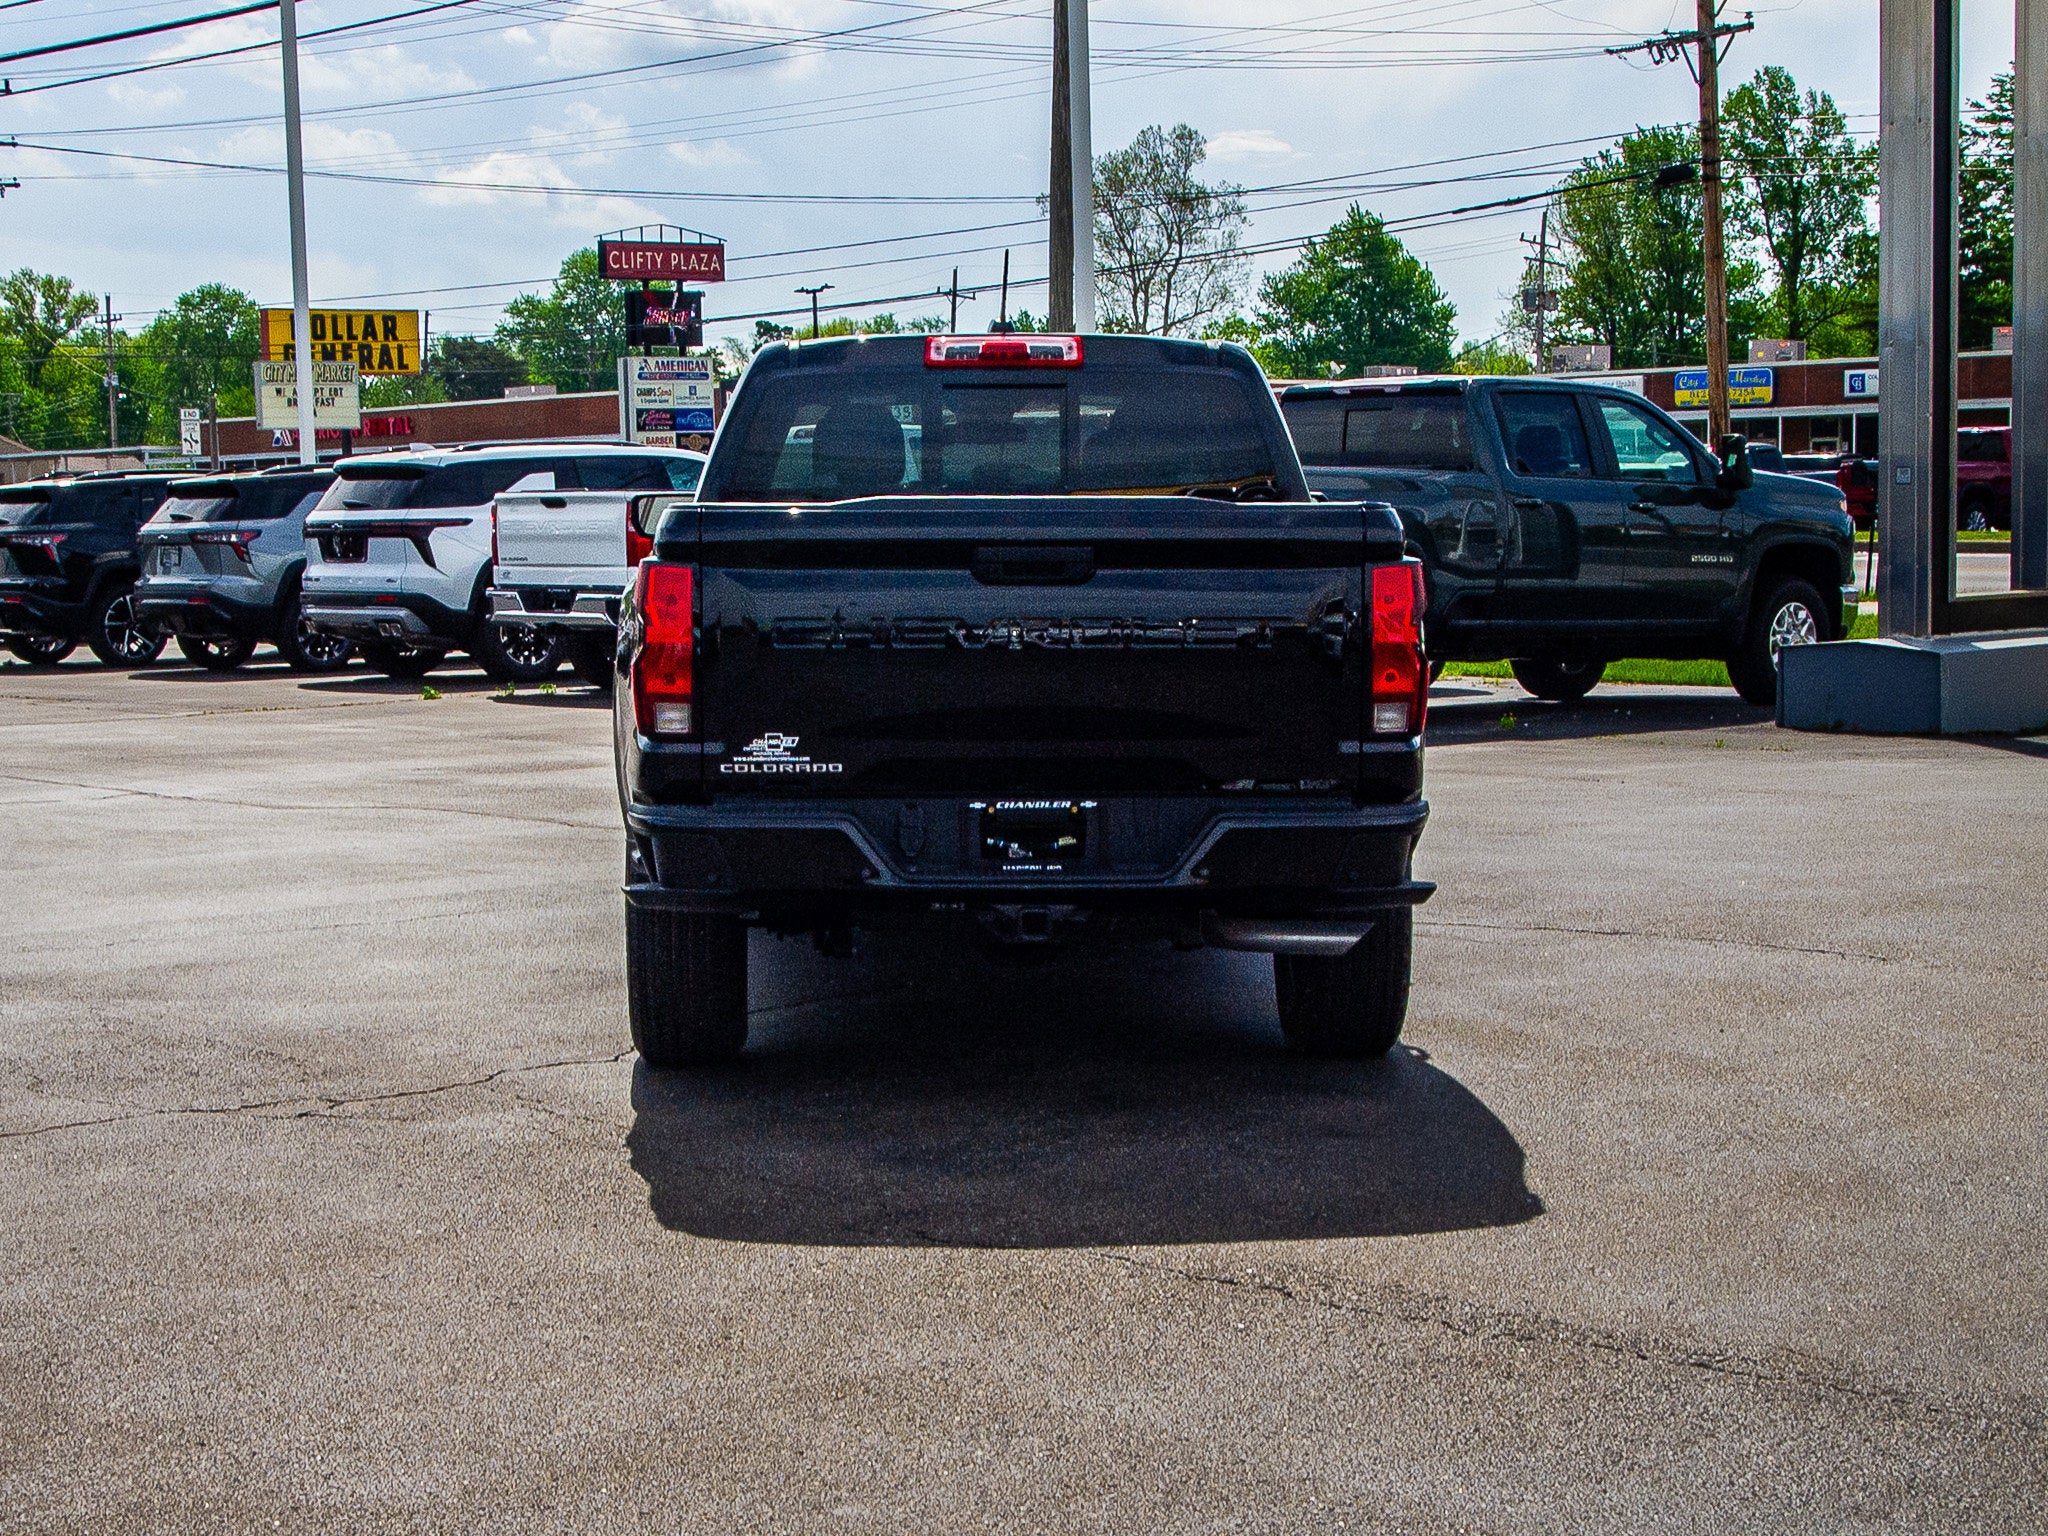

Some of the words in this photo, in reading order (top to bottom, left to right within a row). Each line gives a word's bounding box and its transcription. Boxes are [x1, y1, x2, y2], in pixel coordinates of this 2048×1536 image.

[609, 250, 663, 270] CLIFTY
[671, 252, 721, 271] PLAZA
[655, 360, 708, 372] AMERICAN
[263, 364, 287, 382] CITY
[719, 763, 843, 773] COLORADO
[995, 800, 1072, 809] CHANDLER
